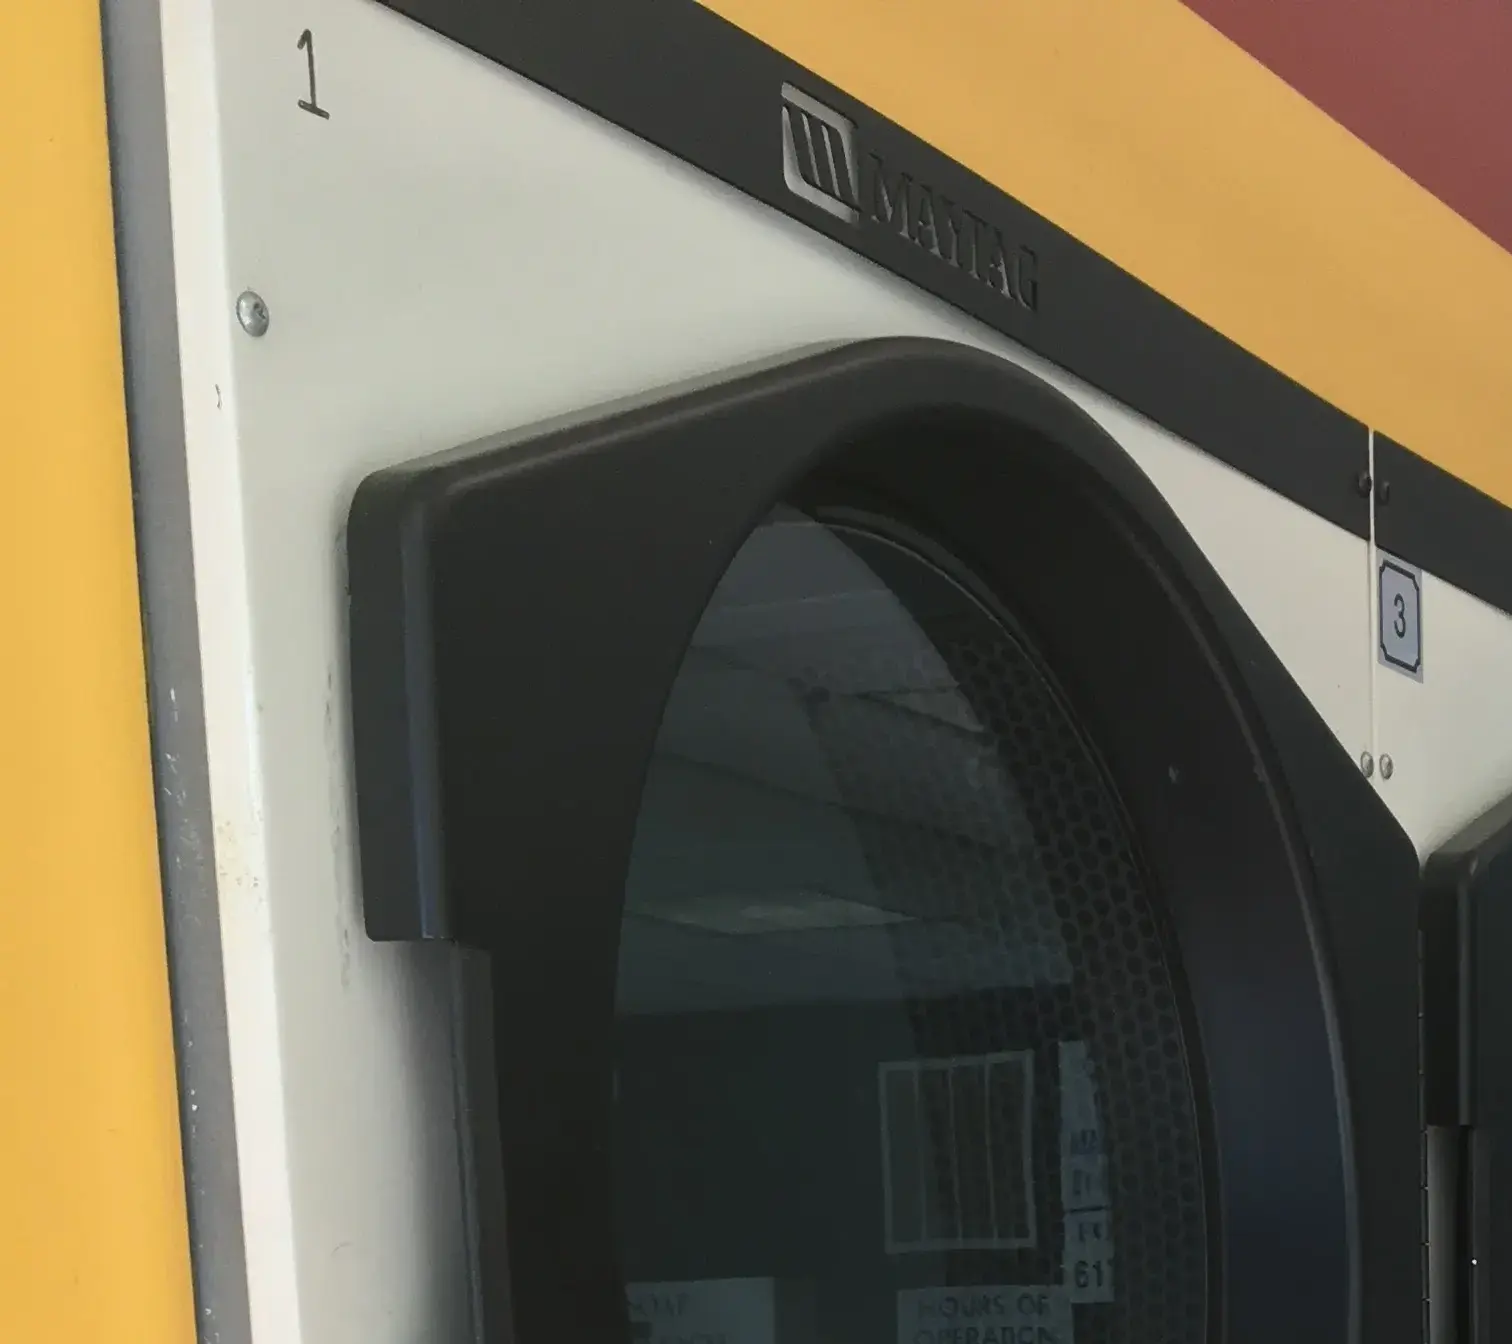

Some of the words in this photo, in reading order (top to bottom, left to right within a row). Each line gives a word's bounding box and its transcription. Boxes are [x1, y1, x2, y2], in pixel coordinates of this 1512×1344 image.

[297, 28, 330, 121] 1
[866, 150, 1038, 312] MAYTAG
[1393, 592, 1406, 640] 3
